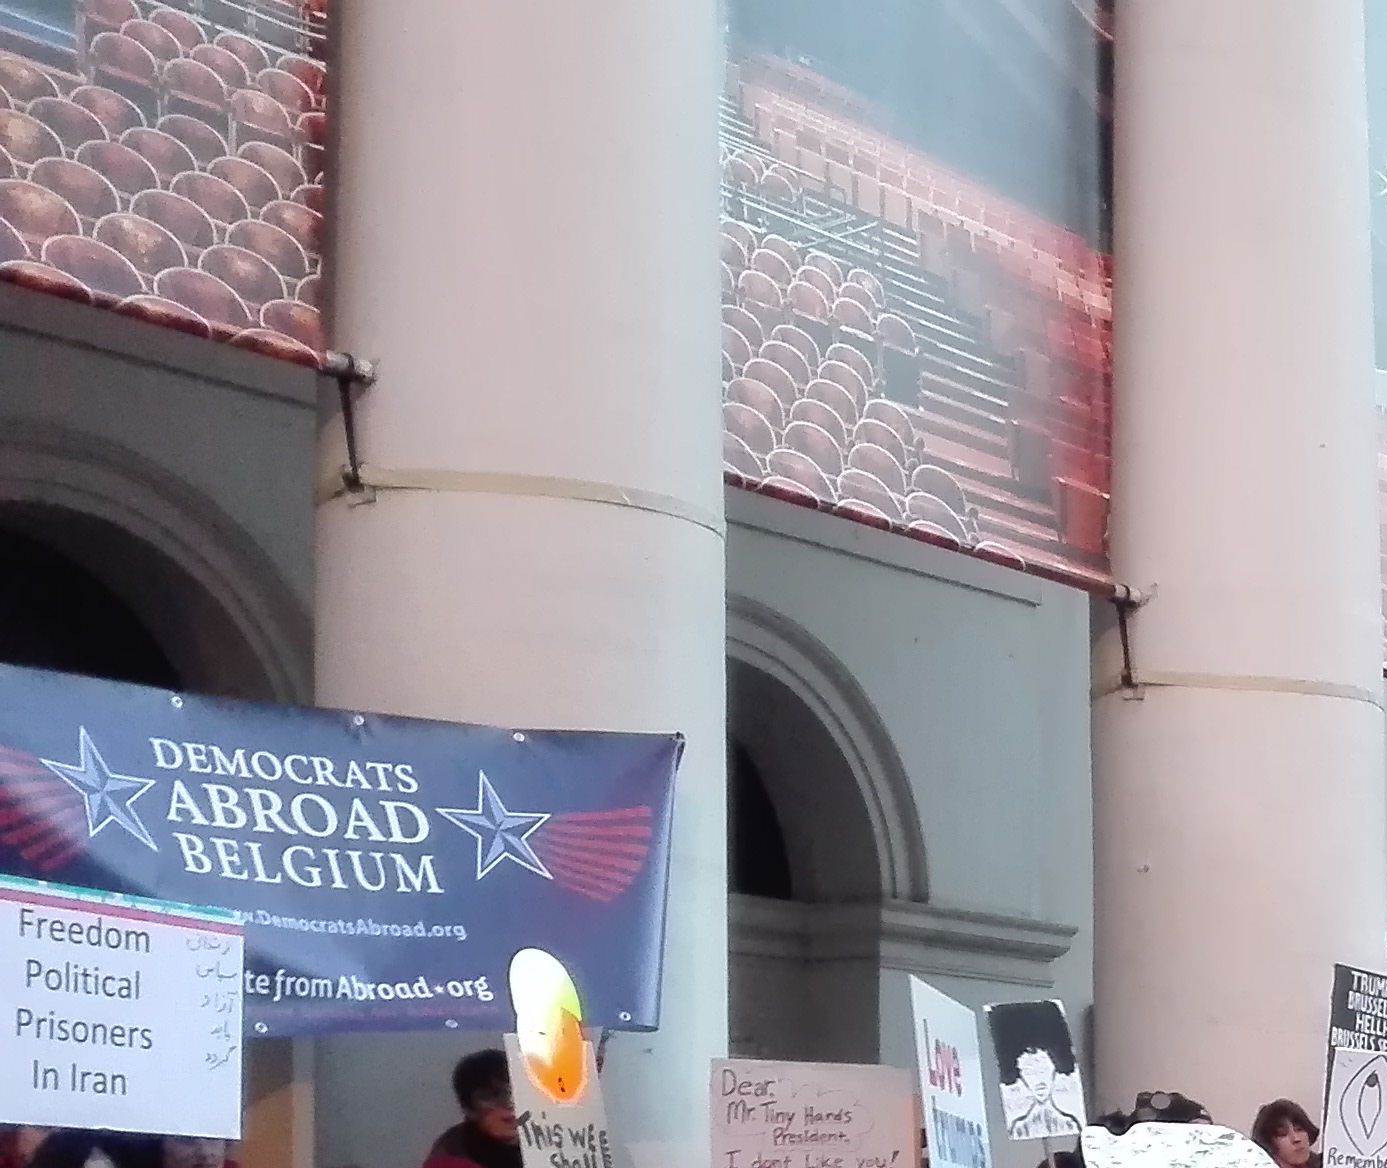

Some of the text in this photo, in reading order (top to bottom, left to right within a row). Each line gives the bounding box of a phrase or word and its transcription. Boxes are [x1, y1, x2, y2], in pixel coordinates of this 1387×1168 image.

[149, 737, 419, 793] DEMOCRATS
[166, 780, 431, 844] ABROAD
[172, 832, 445, 893] BELGIUM
[18, 907, 151, 953] Freedom
[26, 958, 141, 1000] Political
[16, 1007, 153, 1050] Prisoners
[1331, 1026, 1376, 1051] BRUSSELS
[33, 1059, 127, 1096] In Iran
